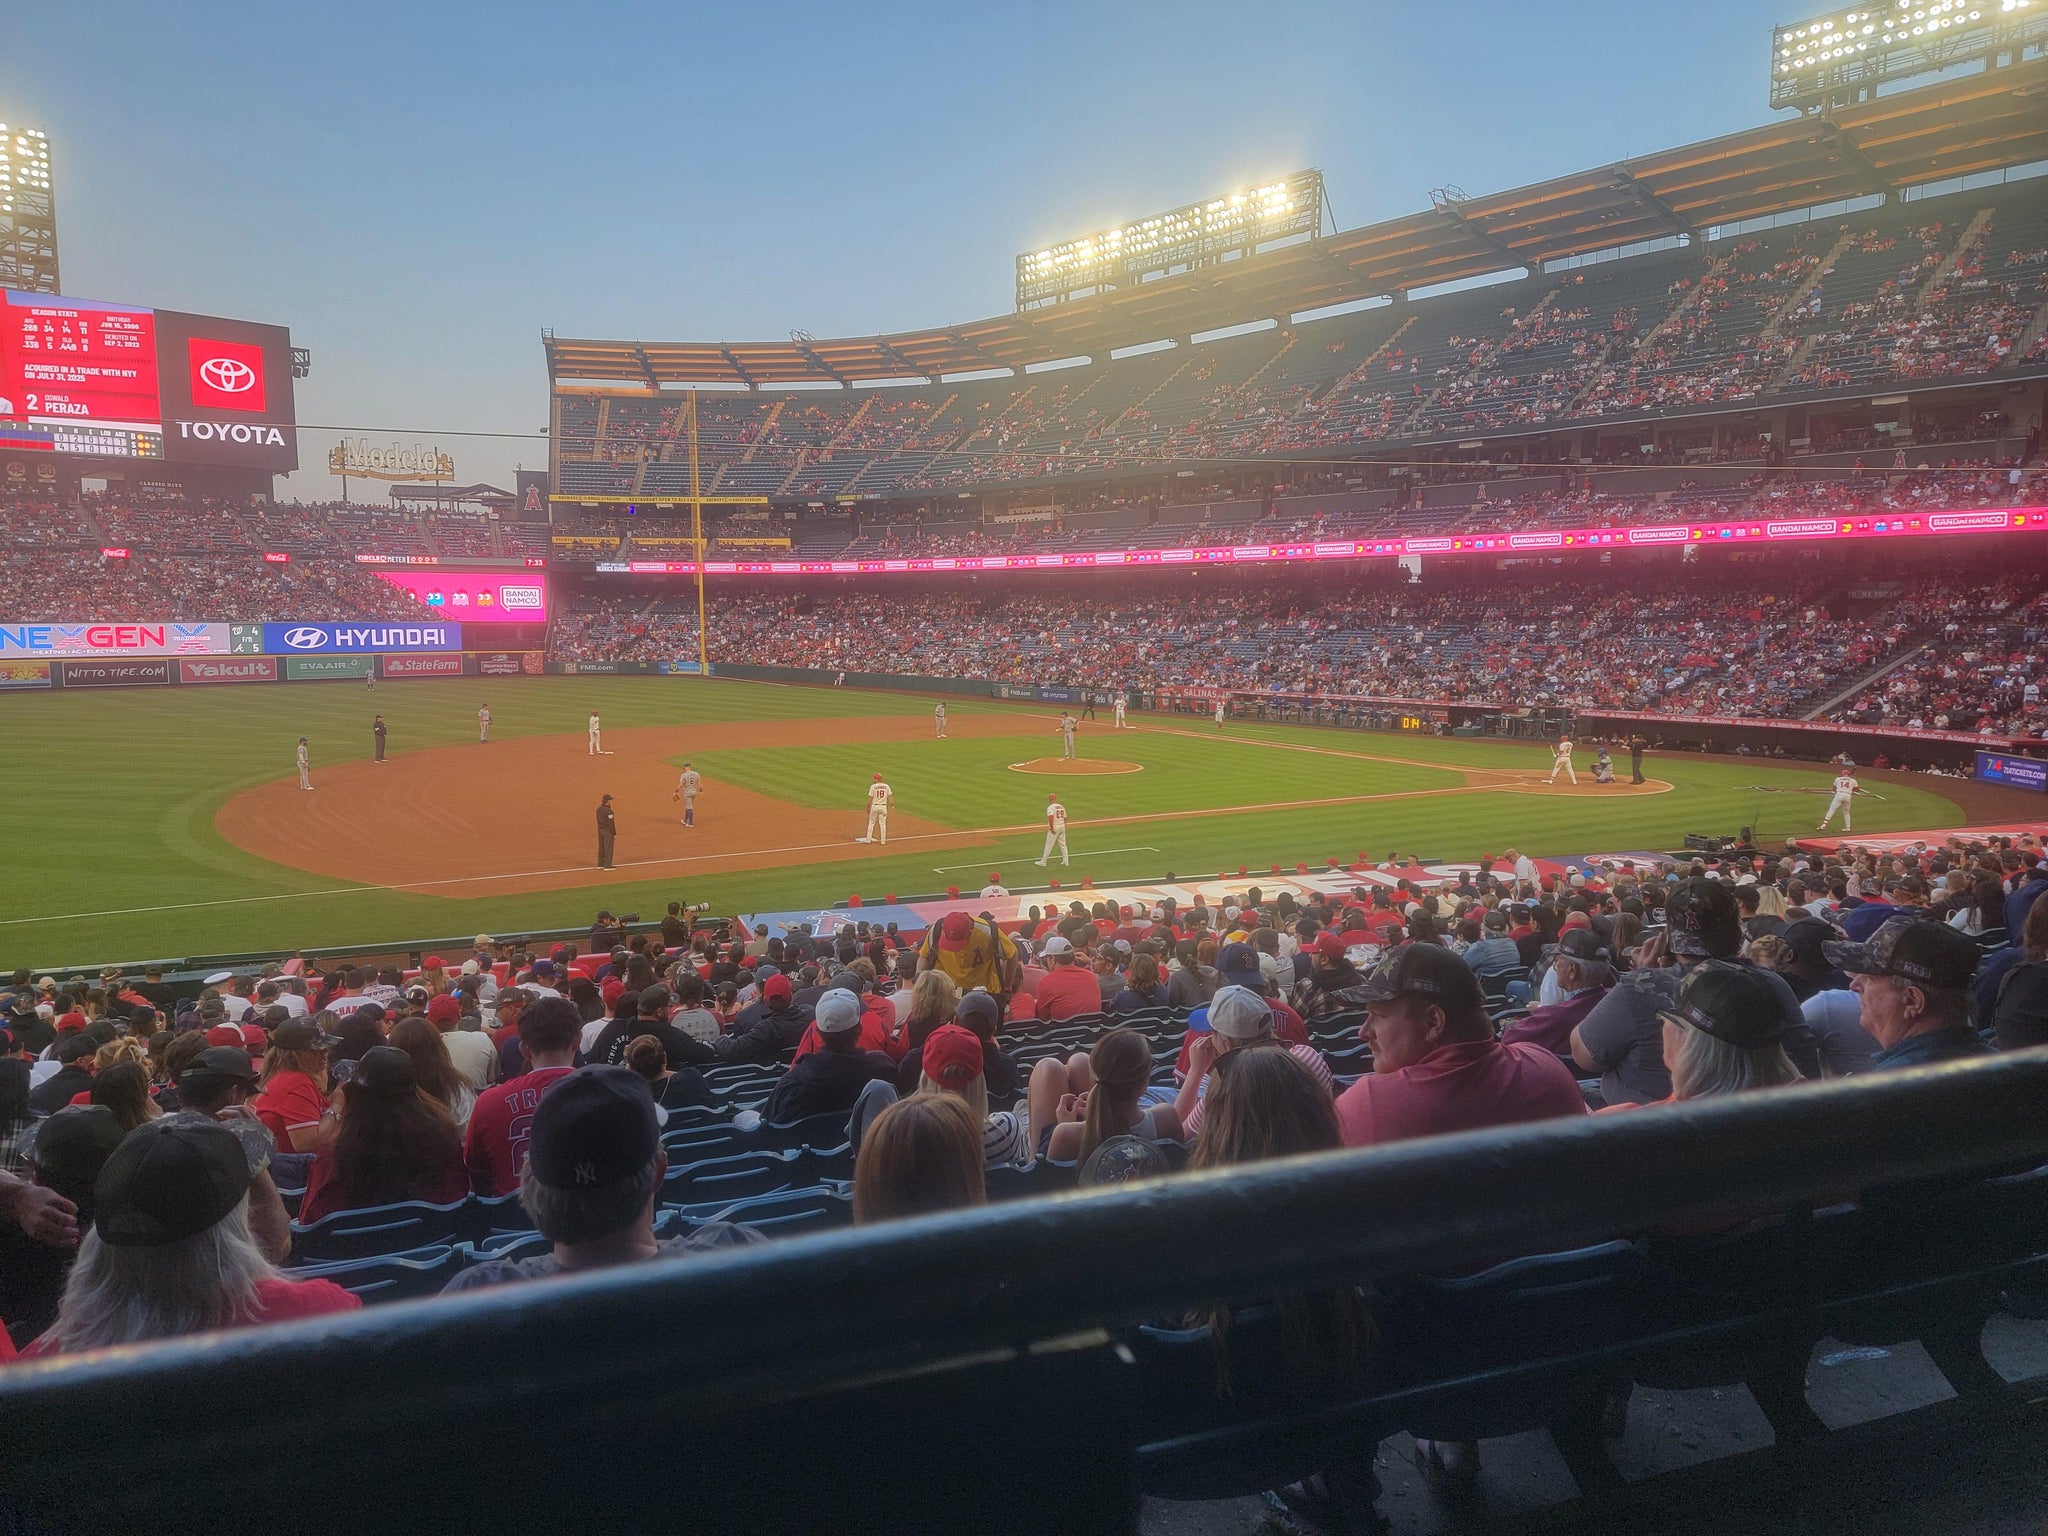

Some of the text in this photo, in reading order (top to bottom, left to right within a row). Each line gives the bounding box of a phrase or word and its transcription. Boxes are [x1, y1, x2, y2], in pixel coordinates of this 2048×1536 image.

[24, 364, 59, 373] ACQUIRED
[77, 367, 100, 375] TRADE
[102, 368, 120, 376] WITH
[122, 370, 137, 378] NYY
[26, 394, 39, 410] 2
[45, 394, 69, 402] OSWALD
[45, 402, 89, 415] PERAZA
[176, 421, 286, 446] TOYOTA
[345, 436, 438, 471] Modelo
[8, 464, 24, 473] 42
[40, 465, 54, 475] 50
[1934, 515, 2003, 526] BANDAI NAMCO
[1771, 523, 1833, 533] BANDAI NAMCO
[252, 627, 258, 635] 4
[336, 628, 446, 646] HYUNDAI
[253, 644, 259, 652] 5
[68, 667, 165, 678] NITTO TIRE.COM
[188, 663, 270, 677] Yakult
[1840, 781, 1850, 789] 14
[876, 790, 885, 798] 18
[575, 1163, 596, 1185] NY
